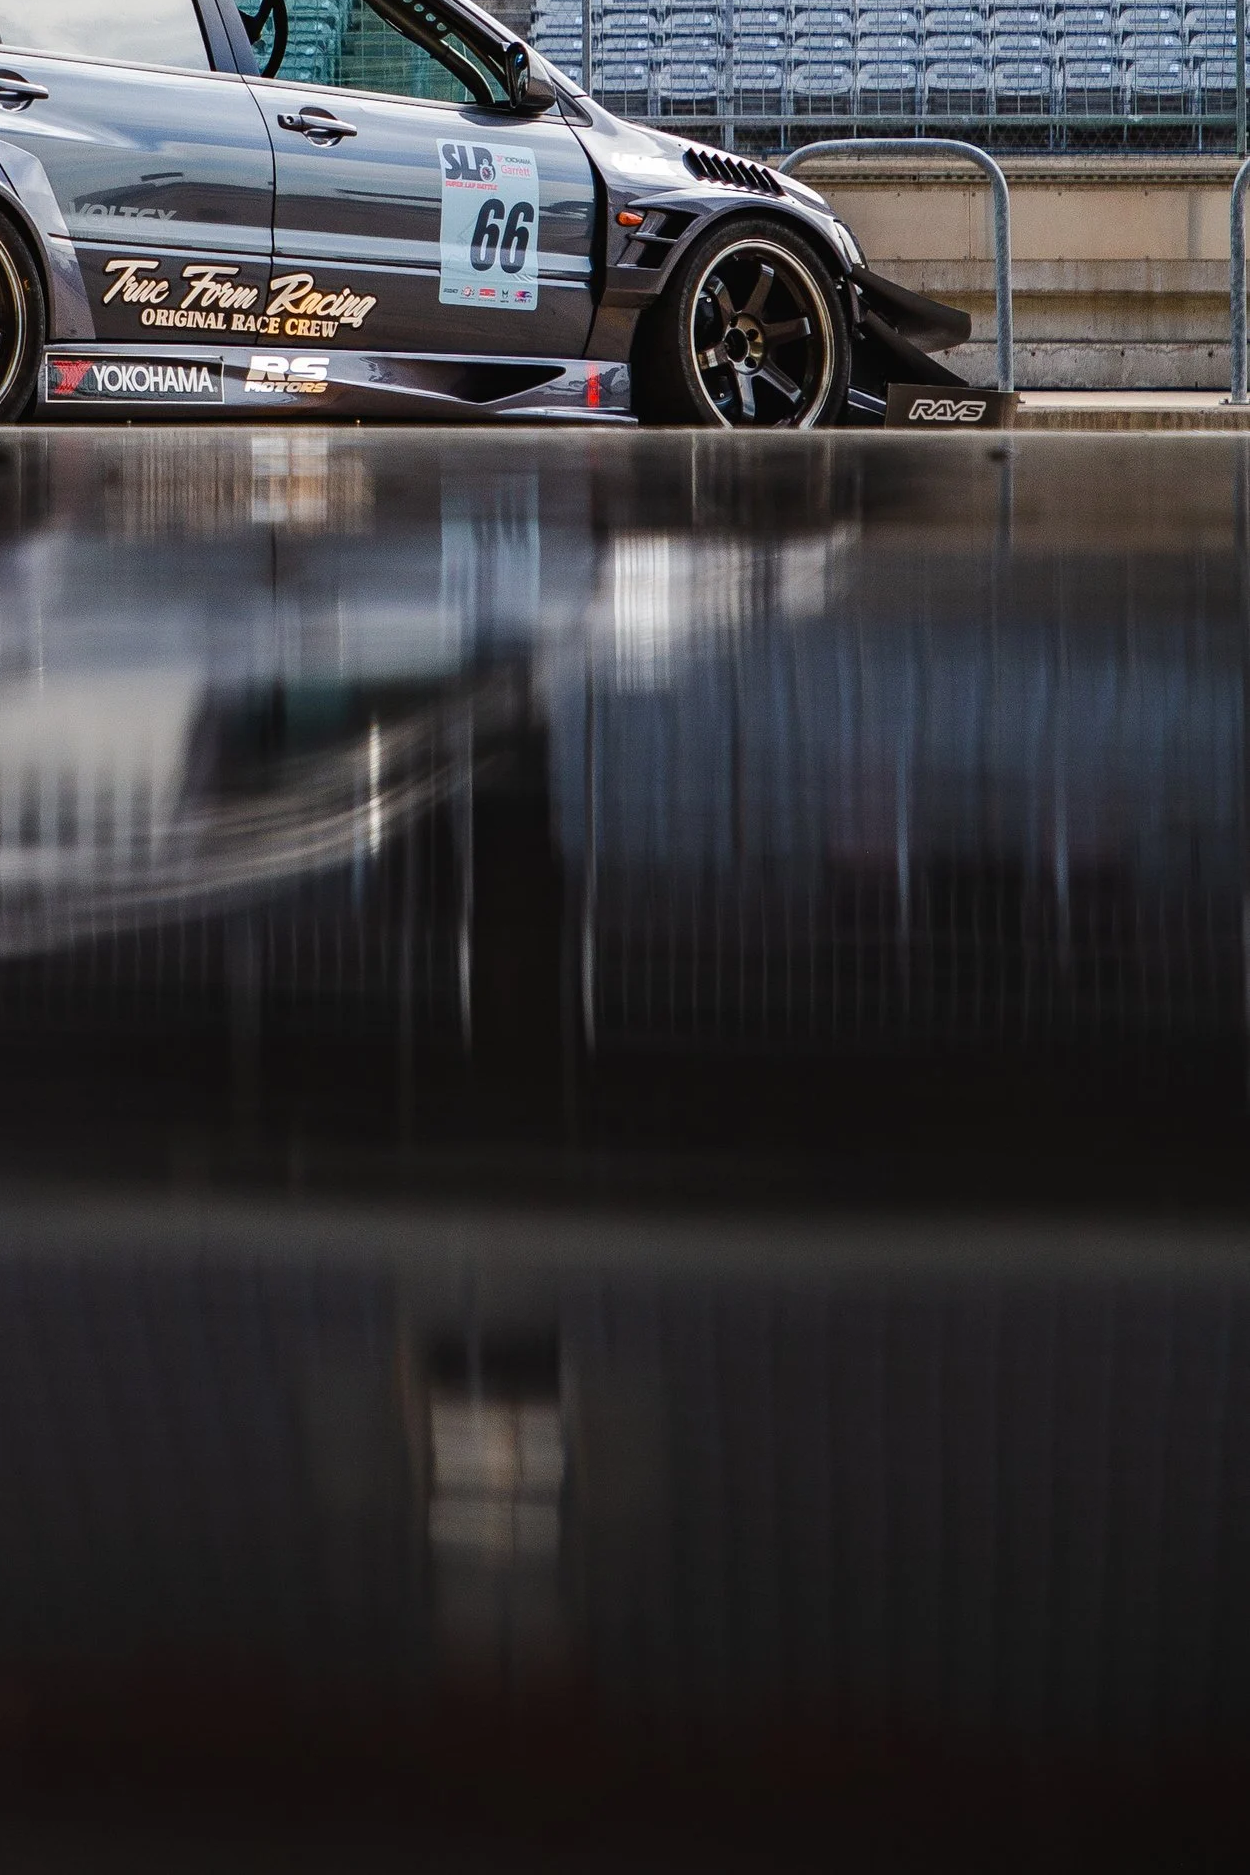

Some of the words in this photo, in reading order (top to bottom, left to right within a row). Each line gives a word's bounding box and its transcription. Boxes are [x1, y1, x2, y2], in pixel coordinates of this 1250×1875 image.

[501, 165, 531, 178] Garrett
[470, 198, 535, 274] 66
[104, 260, 169, 305] True
[181, 265, 258, 309] Form
[266, 273, 378, 328] Racing
[141, 308, 227, 331] ORIGINAL
[231, 314, 281, 335] RACE
[284, 317, 338, 338] CREW
[91, 365, 214, 393] YOKOHAMA
[249, 355, 330, 382] RS
[244, 381, 329, 394] MOTORS
[909, 399, 987, 422] RAYS
